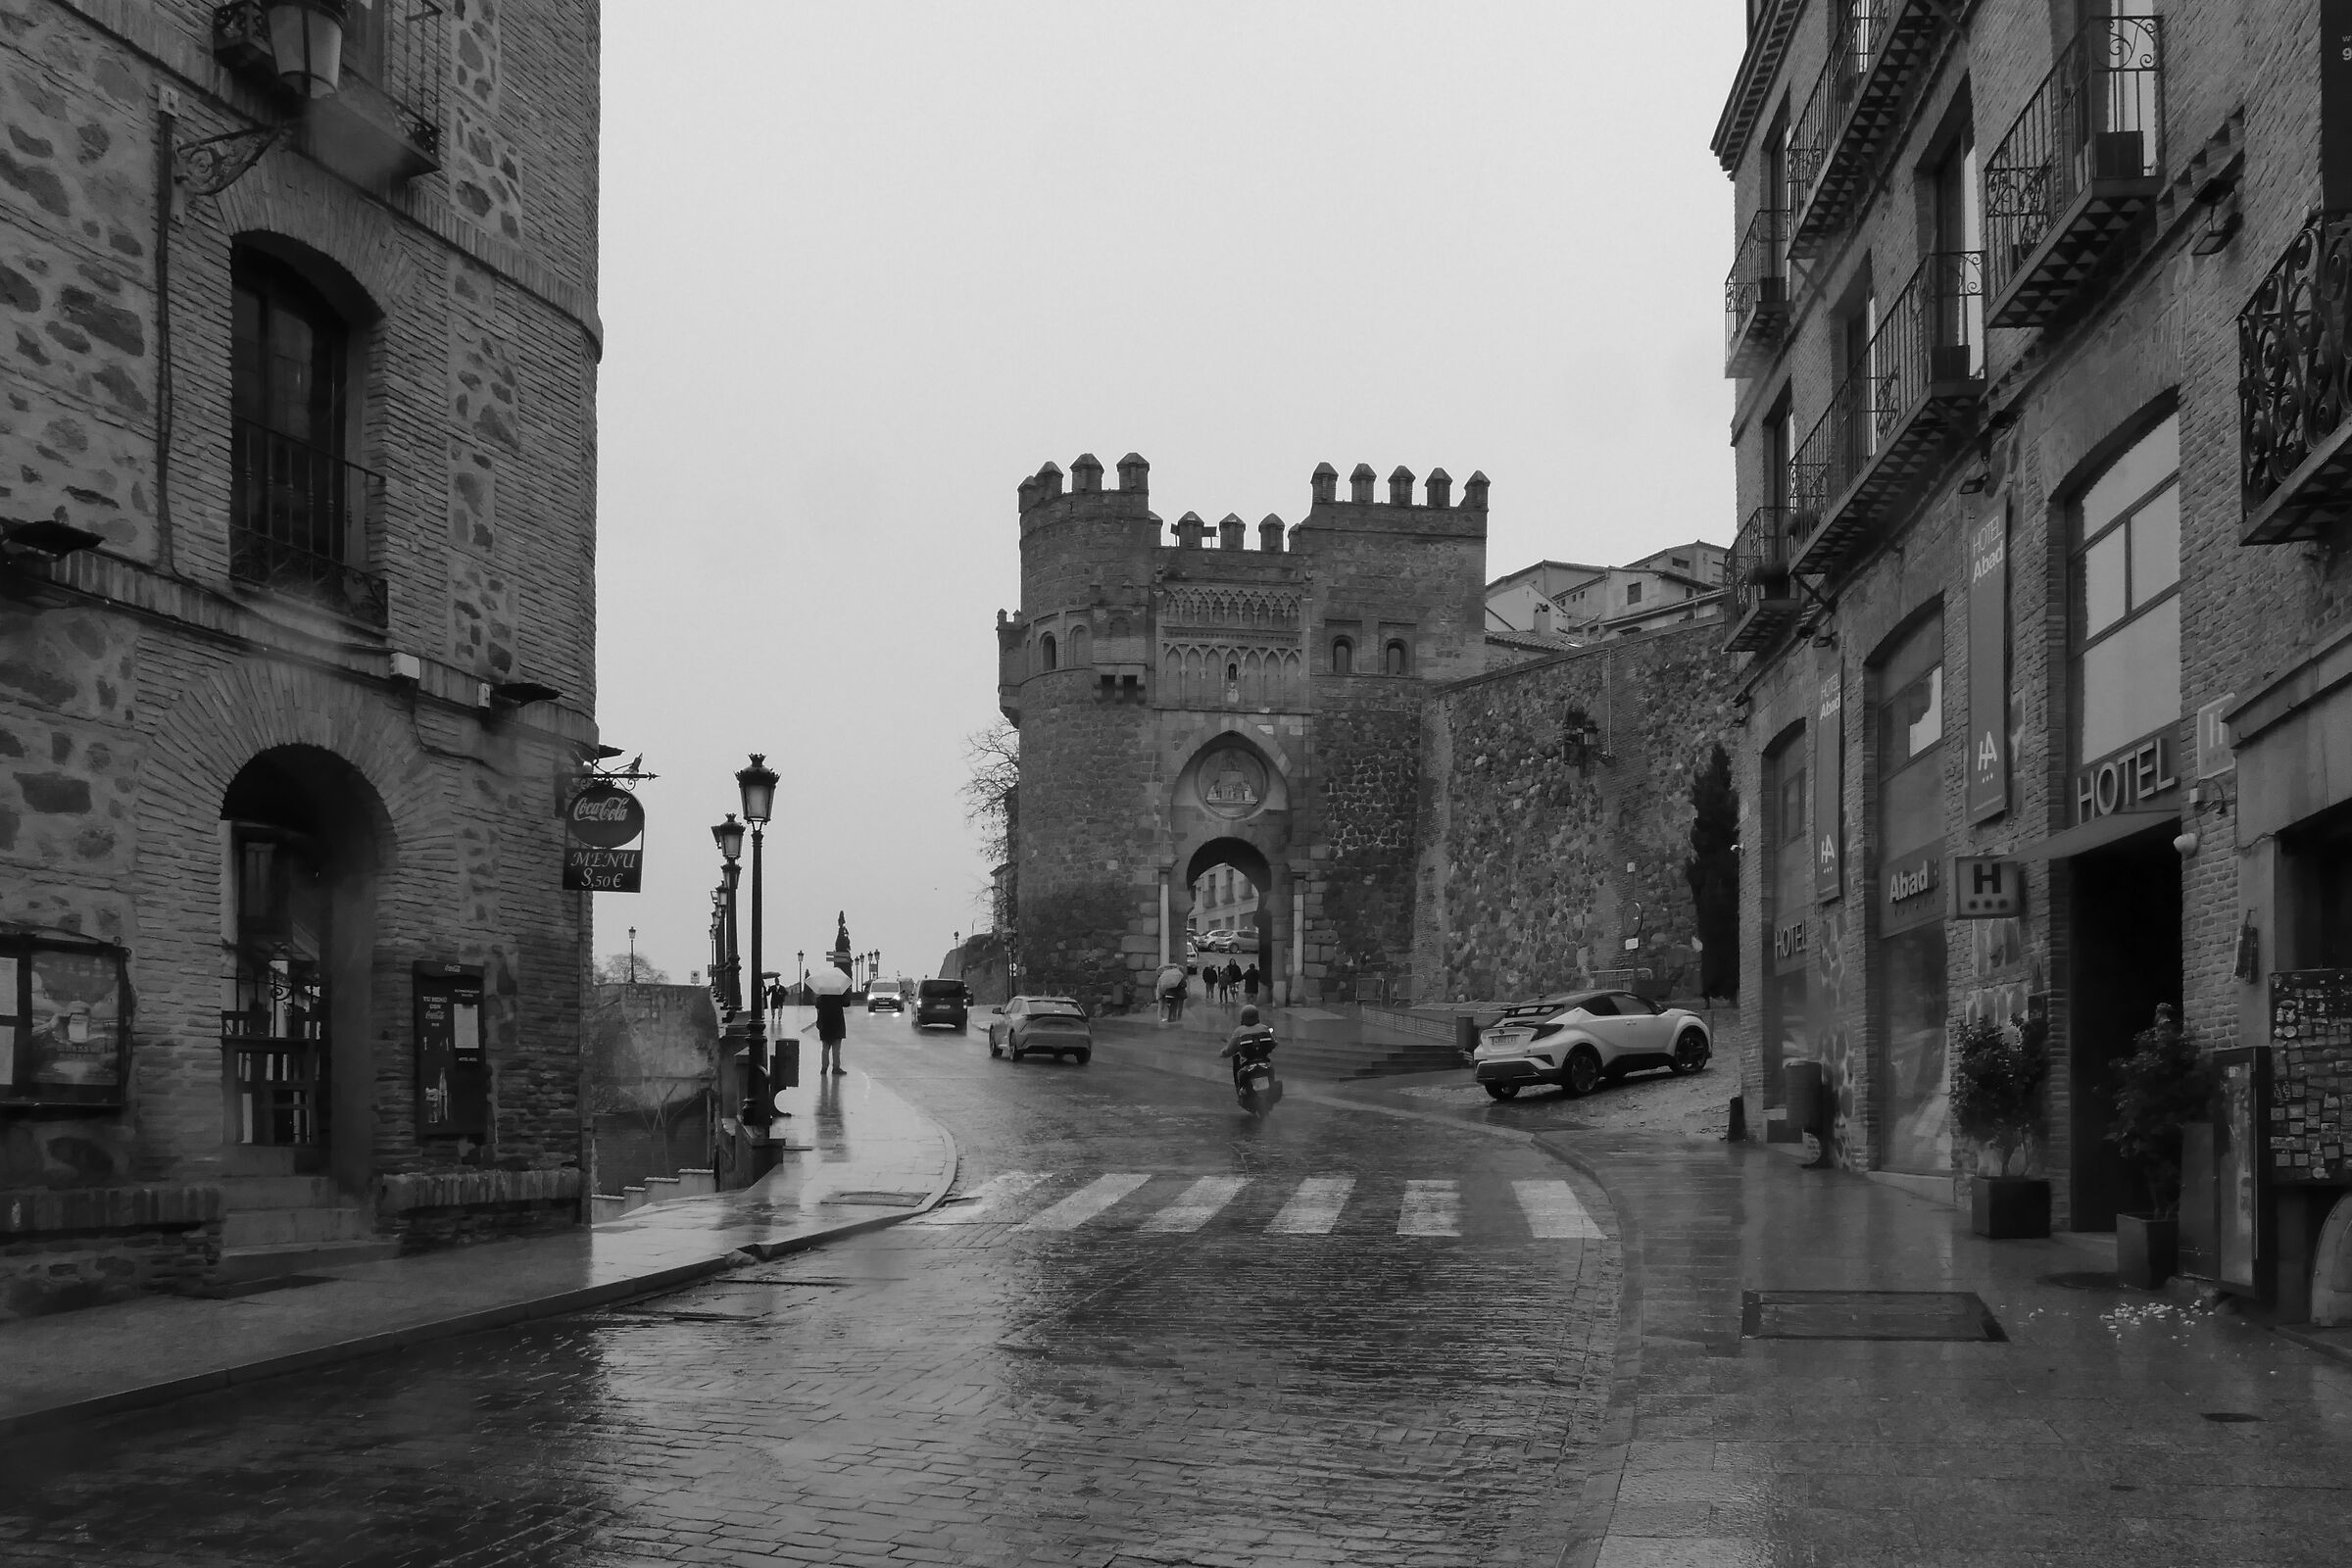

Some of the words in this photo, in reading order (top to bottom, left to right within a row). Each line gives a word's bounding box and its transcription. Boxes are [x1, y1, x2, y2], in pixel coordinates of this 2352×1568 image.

[1973, 515, 2003, 557] HOTEL
[1973, 540, 2003, 583] Abad
[1820, 672, 1840, 702] HOTEL
[1820, 692, 1840, 720] Abad
[2078, 737, 2175, 825] HOTEL
[570, 851, 635, 868] MENU
[1974, 863, 2001, 894] H
[1888, 860, 1928, 904] Abad
[1775, 920, 1806, 961] HOTEL
